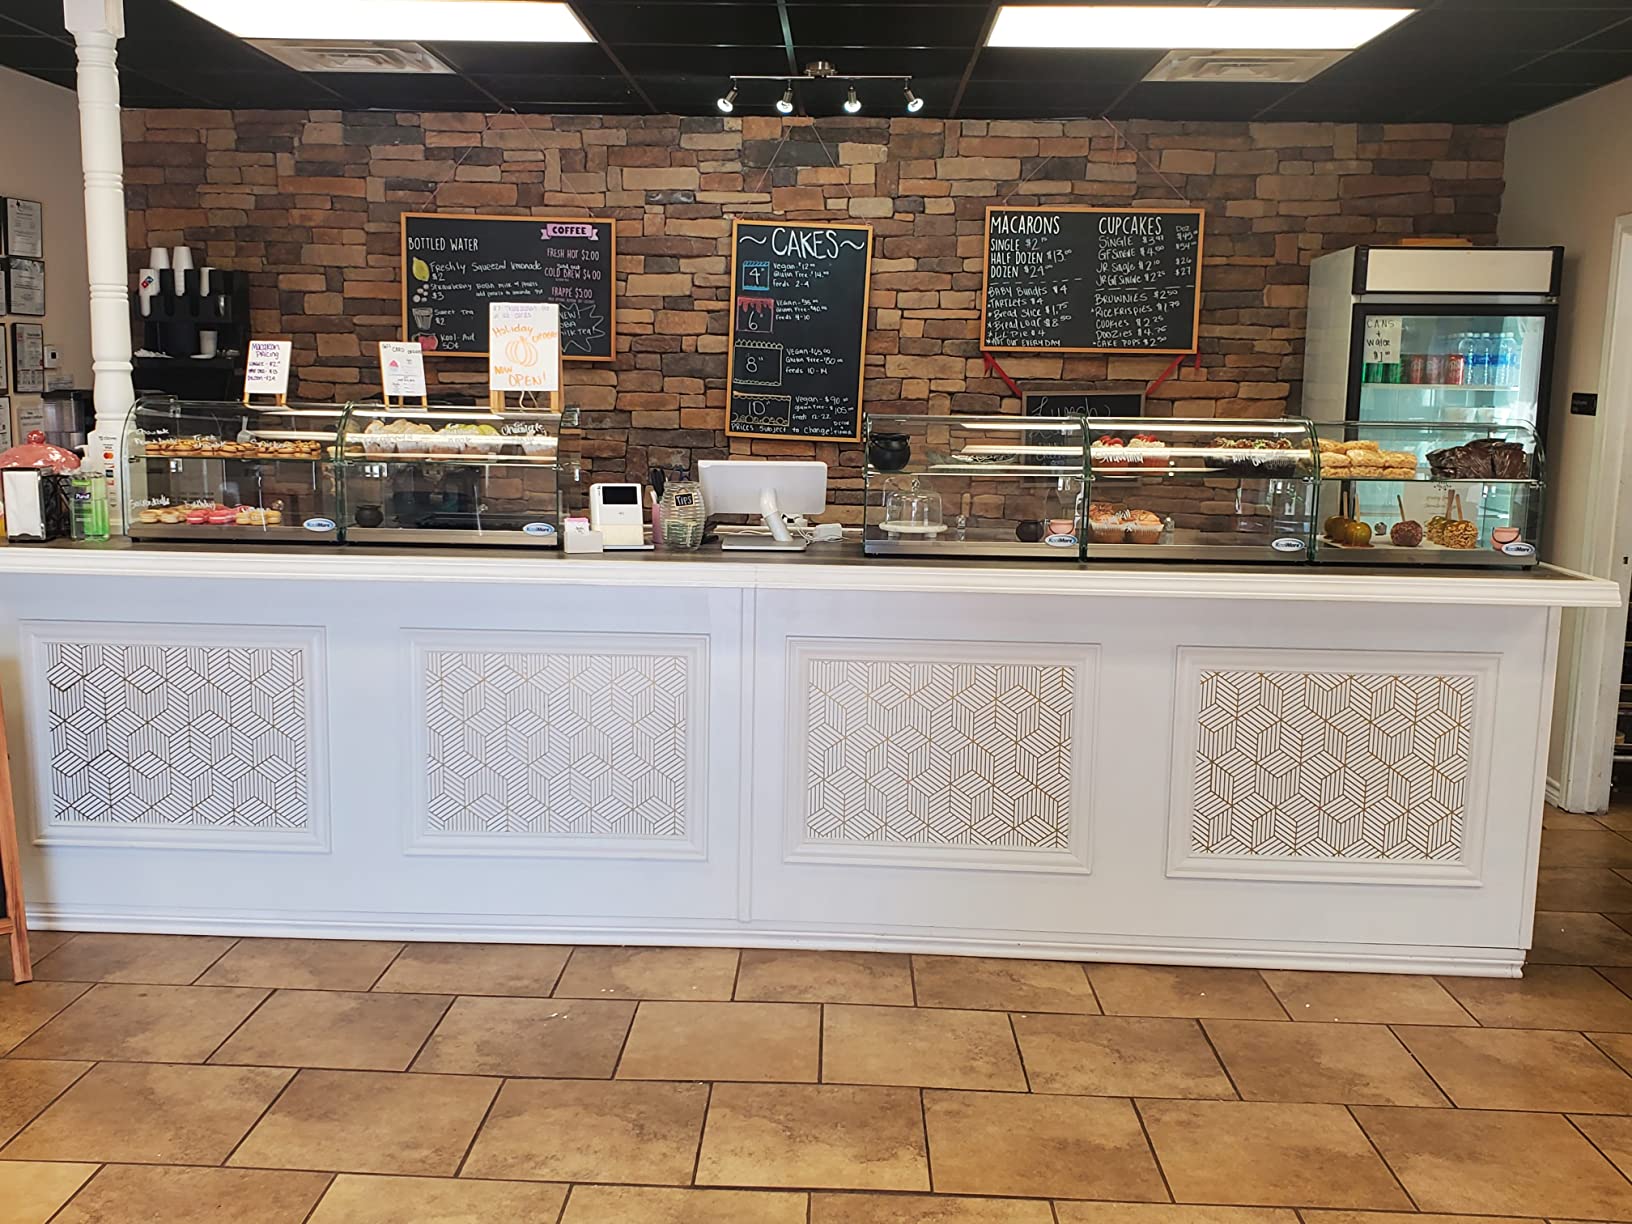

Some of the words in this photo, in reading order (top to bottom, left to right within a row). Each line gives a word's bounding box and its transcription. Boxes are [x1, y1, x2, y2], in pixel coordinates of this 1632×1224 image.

[551, 226, 587, 235] COFFEE
[990, 215, 1061, 235] MACARONS
[1098, 215, 1163, 235] CUPCAKES
[408, 237, 446, 251] BOTTLED
[449, 238, 480, 251] WATER
[772, 227, 839, 260] CAKES
[990, 238, 1020, 251] SINGLE
[546, 247, 565, 258] FRESH
[566, 248, 579, 259] HOT
[990, 251, 1011, 265] HALF
[1015, 252, 1043, 265] DOZEN
[544, 267, 561, 277] COLD
[563, 268, 581, 279] BREW
[990, 265, 1019, 278] DOZEN
[1095, 262, 1108, 273] JR
[431, 272, 446, 281] $2
[431, 292, 445, 301] $3
[989, 285, 1013, 297] BABY
[1052, 284, 1068, 295] $4
[1029, 297, 1044, 305] $4
[1094, 293, 1149, 306] BROWNIES
[993, 308, 1018, 320] Bread
[435, 317, 446, 326] $2
[992, 317, 1019, 331] Bread
[1366, 319, 1395, 329] CANS
[492, 323, 534, 338] Holiday
[1096, 339, 1118, 347] CAKE
[675, 495, 693, 506] TIPS
